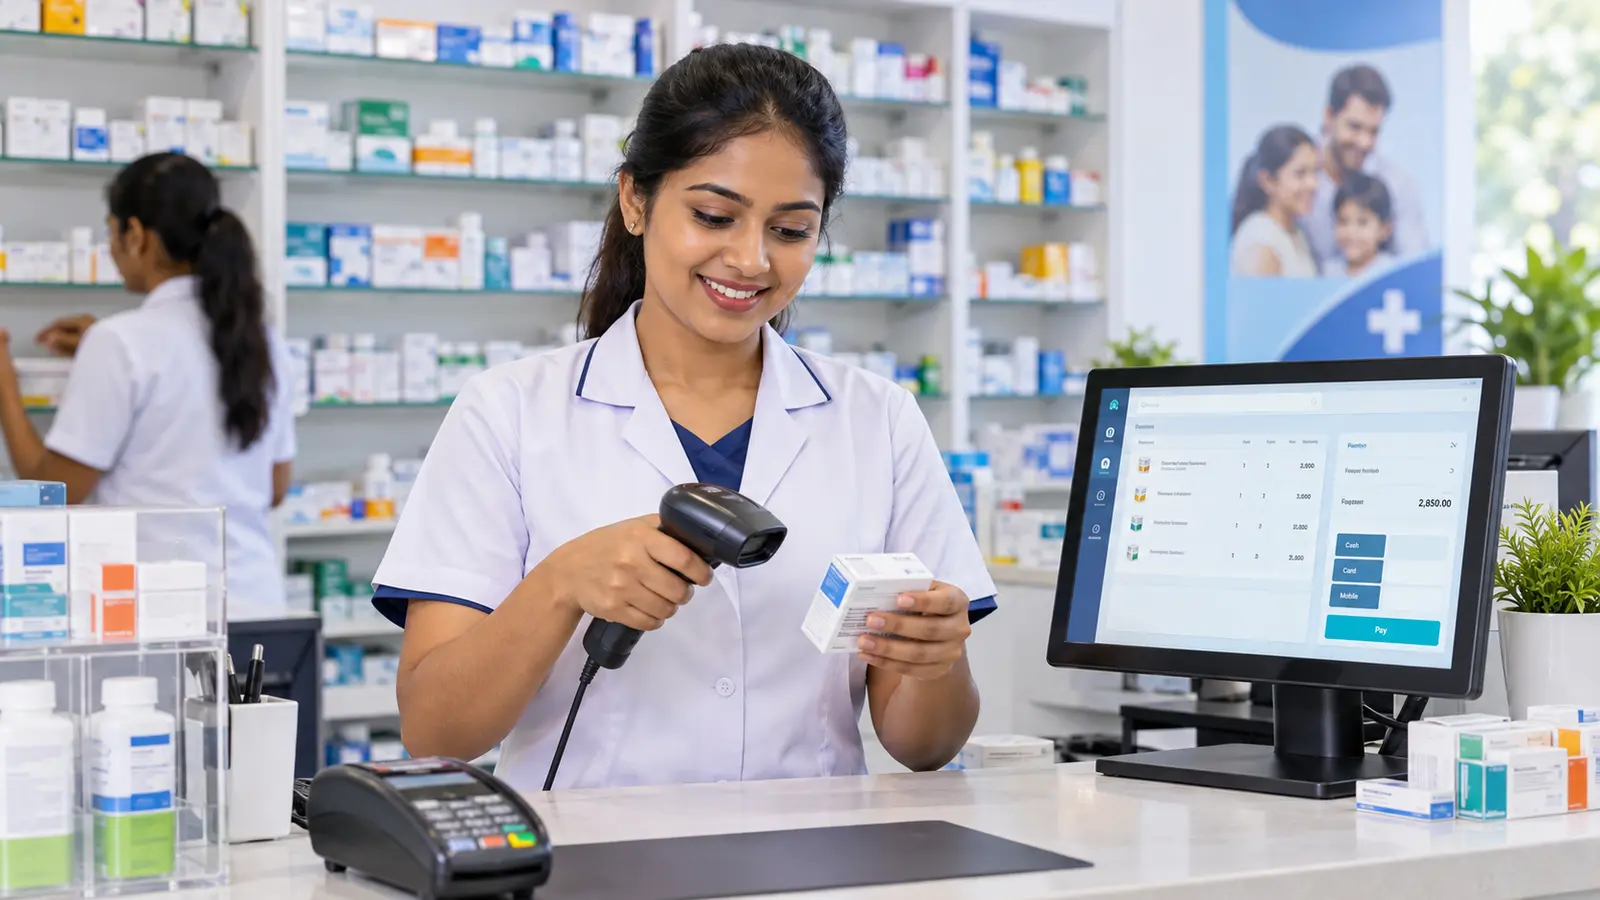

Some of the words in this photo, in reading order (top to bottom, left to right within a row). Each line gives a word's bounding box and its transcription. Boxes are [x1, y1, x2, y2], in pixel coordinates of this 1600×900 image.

[1418, 498, 1452, 508] 2,850.00
[1345, 541, 1359, 549] Cash
[1340, 592, 1358, 600] Mobile
[1374, 626, 1387, 636] Pay
